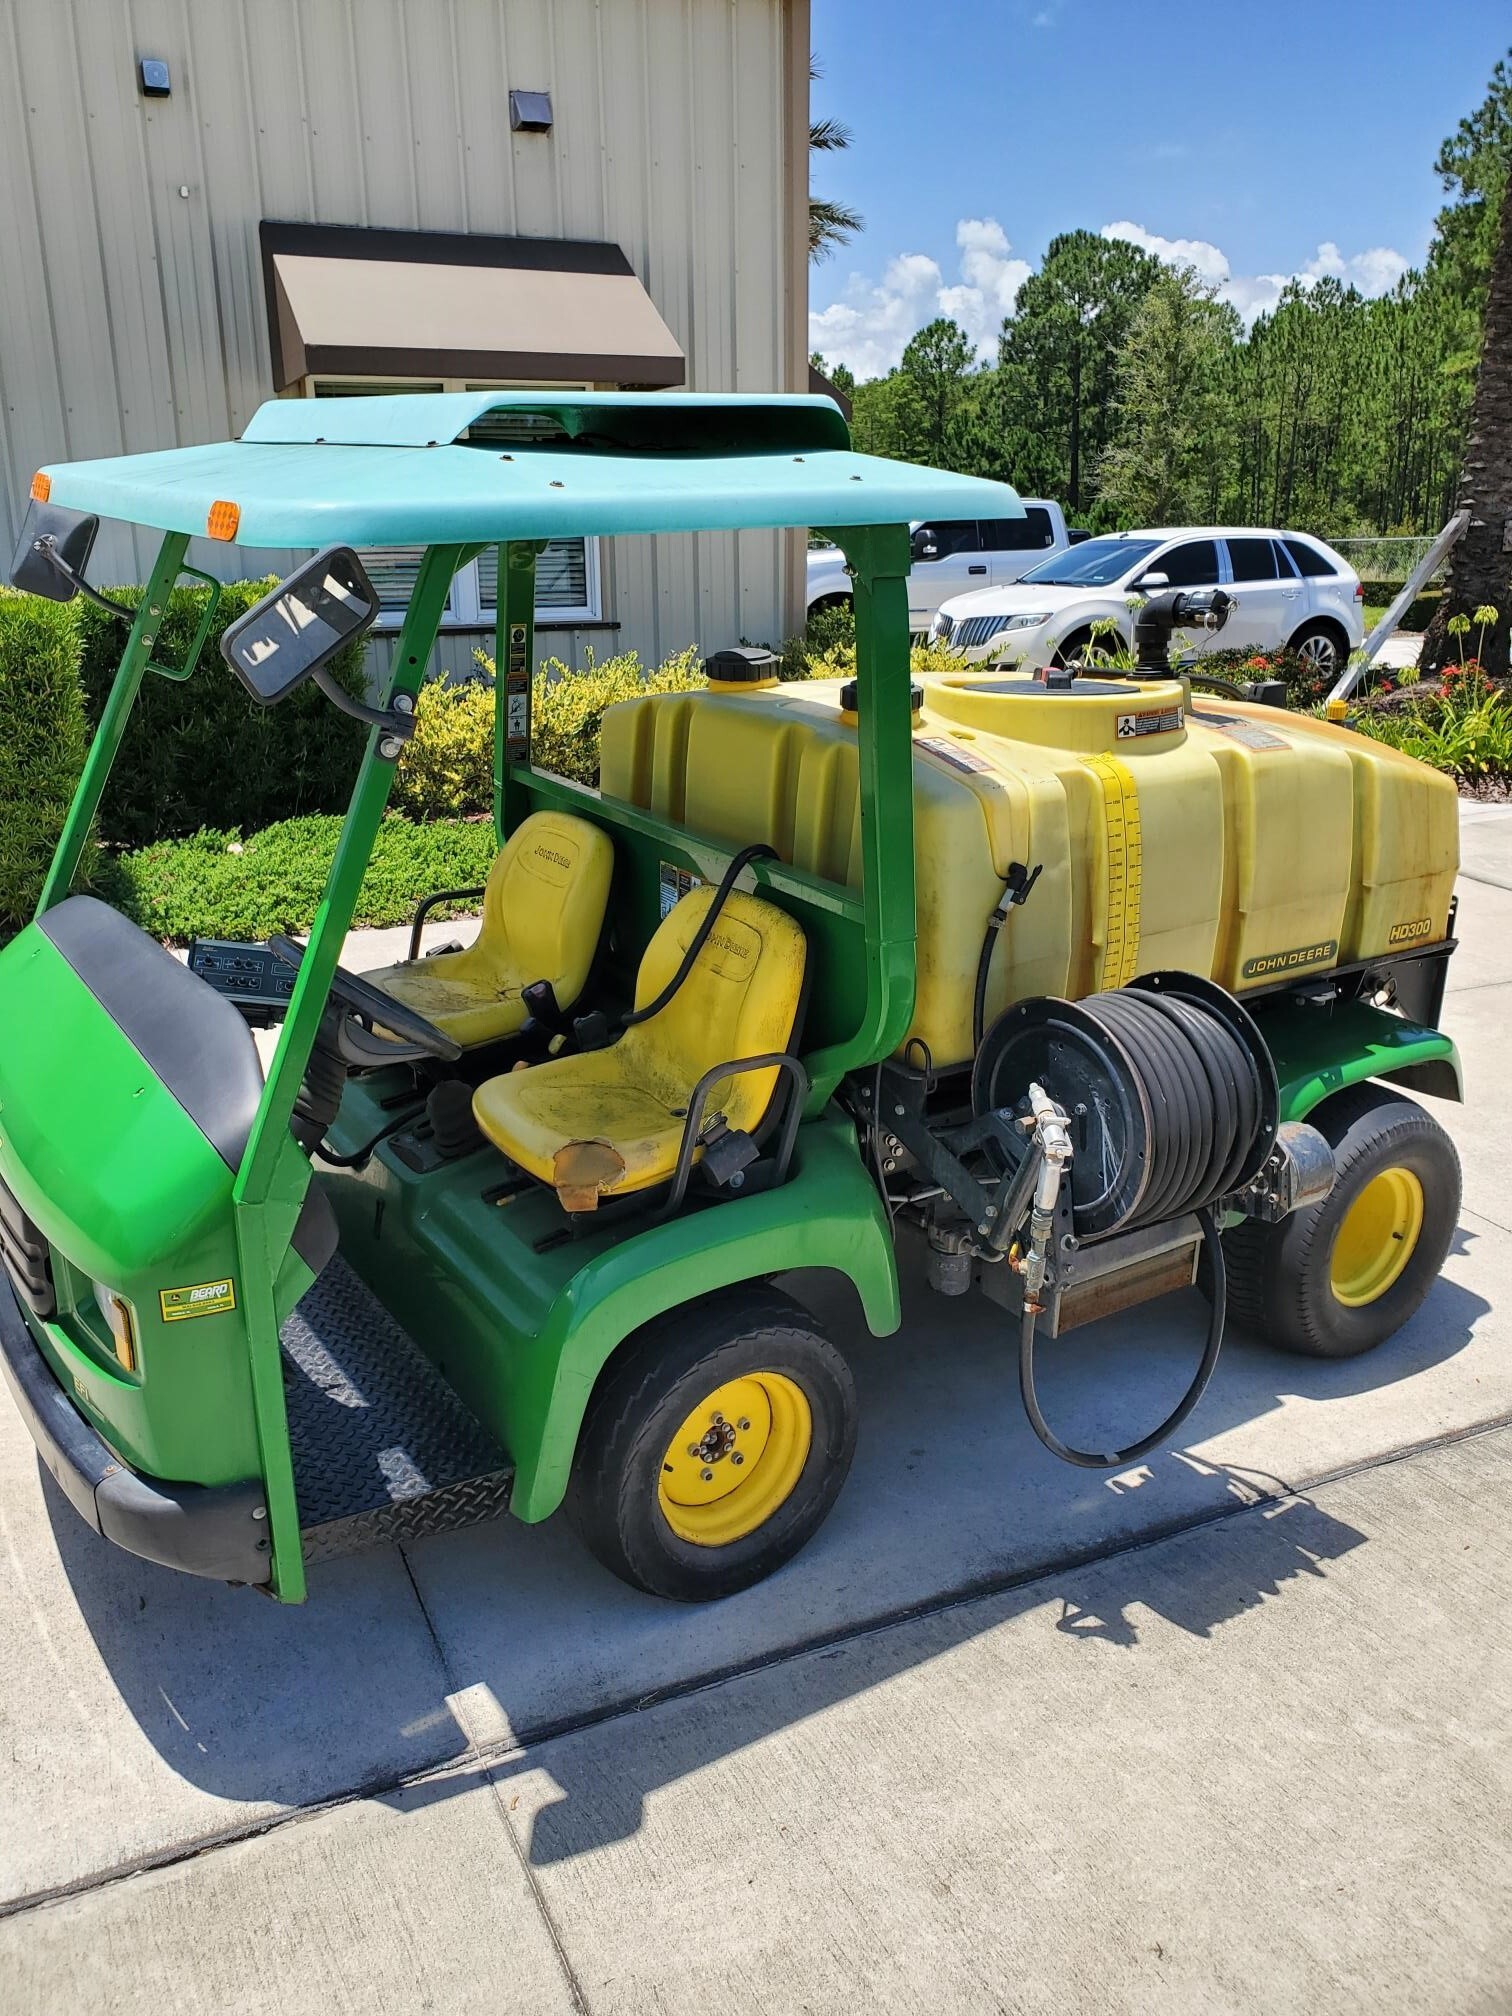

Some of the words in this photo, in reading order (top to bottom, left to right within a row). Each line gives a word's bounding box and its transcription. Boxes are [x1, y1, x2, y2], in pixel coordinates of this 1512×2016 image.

[1389, 918, 1431, 942] HD300
[1248, 956, 1287, 974] JOHN
[1288, 945, 1331, 965] DEERE
[189, 1283, 229, 1302] BEARD
